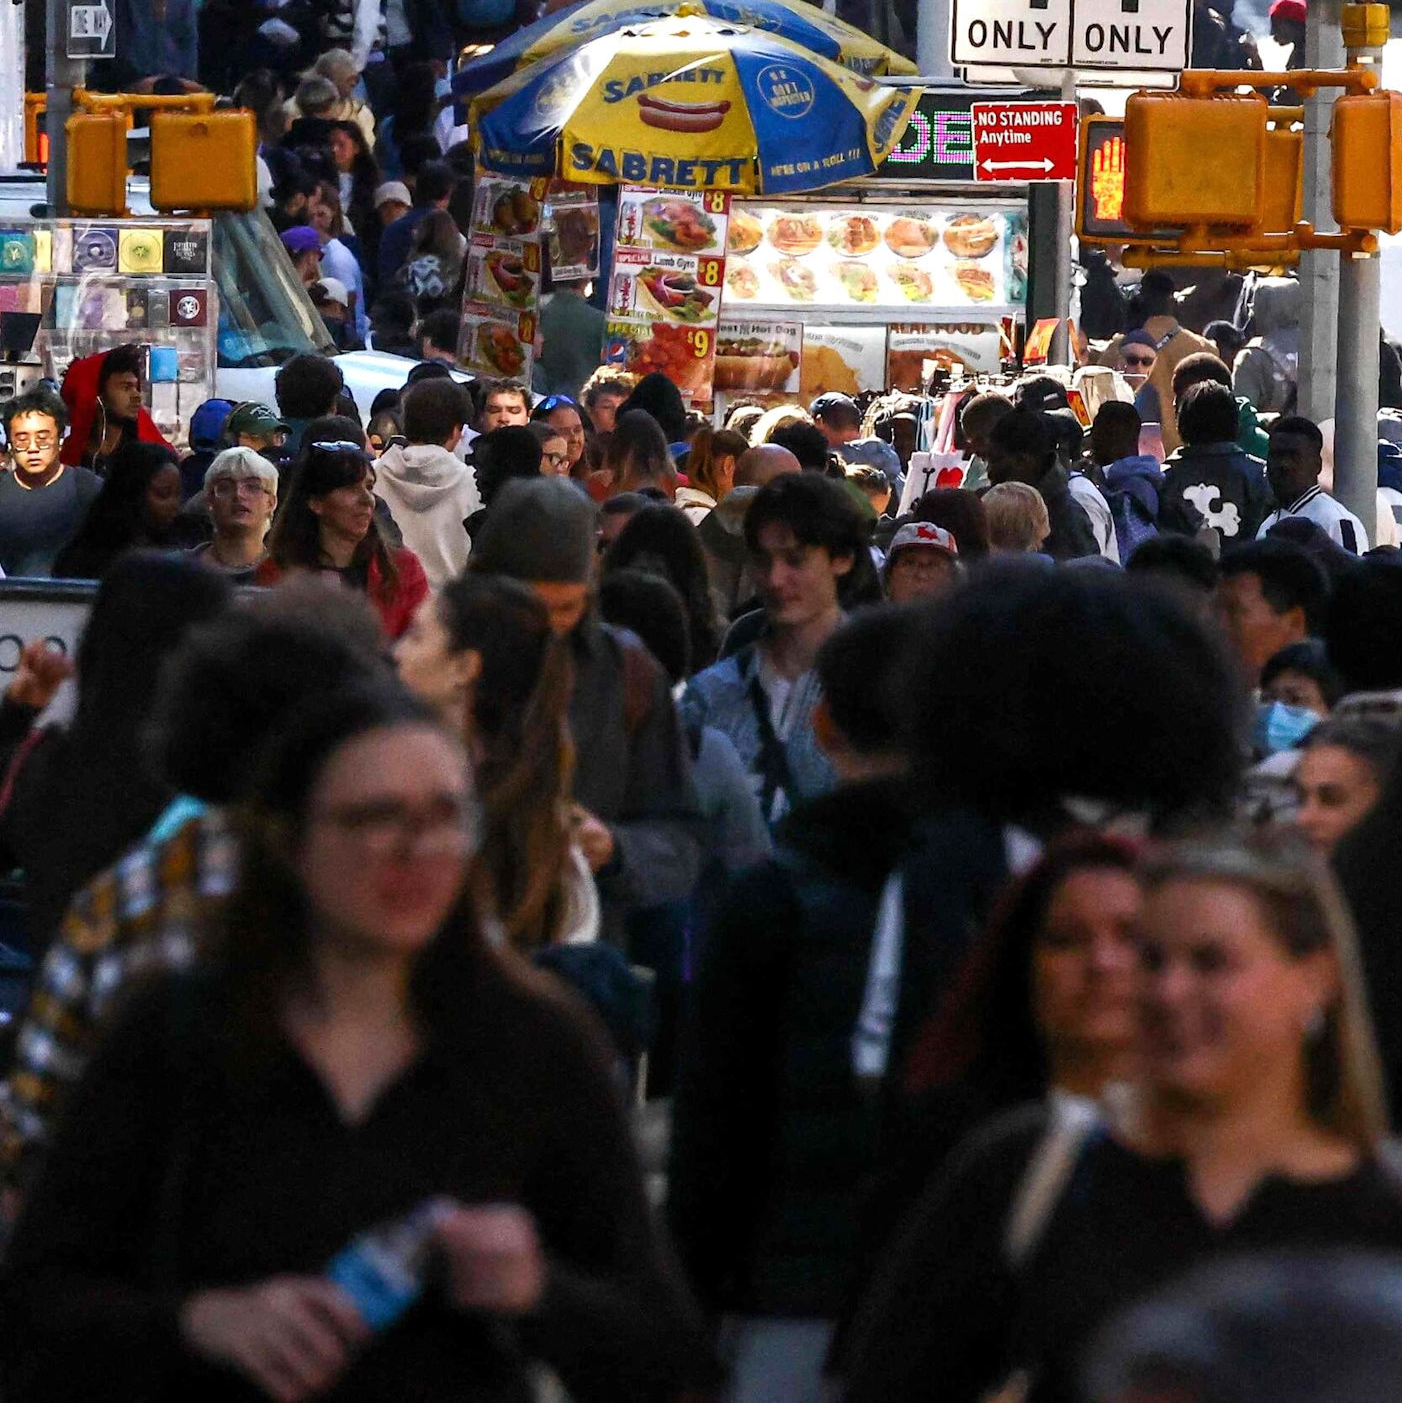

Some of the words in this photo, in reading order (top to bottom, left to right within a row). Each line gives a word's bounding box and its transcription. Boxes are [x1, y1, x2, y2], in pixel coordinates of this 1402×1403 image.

[967, 19, 1058, 50] ONLY
[1085, 23, 1173, 55] ONLY
[978, 111, 997, 126] NO
[1000, 110, 1063, 127] STANDING
[980, 128, 1032, 147] Anytime
[571, 143, 750, 187] SABRETT
